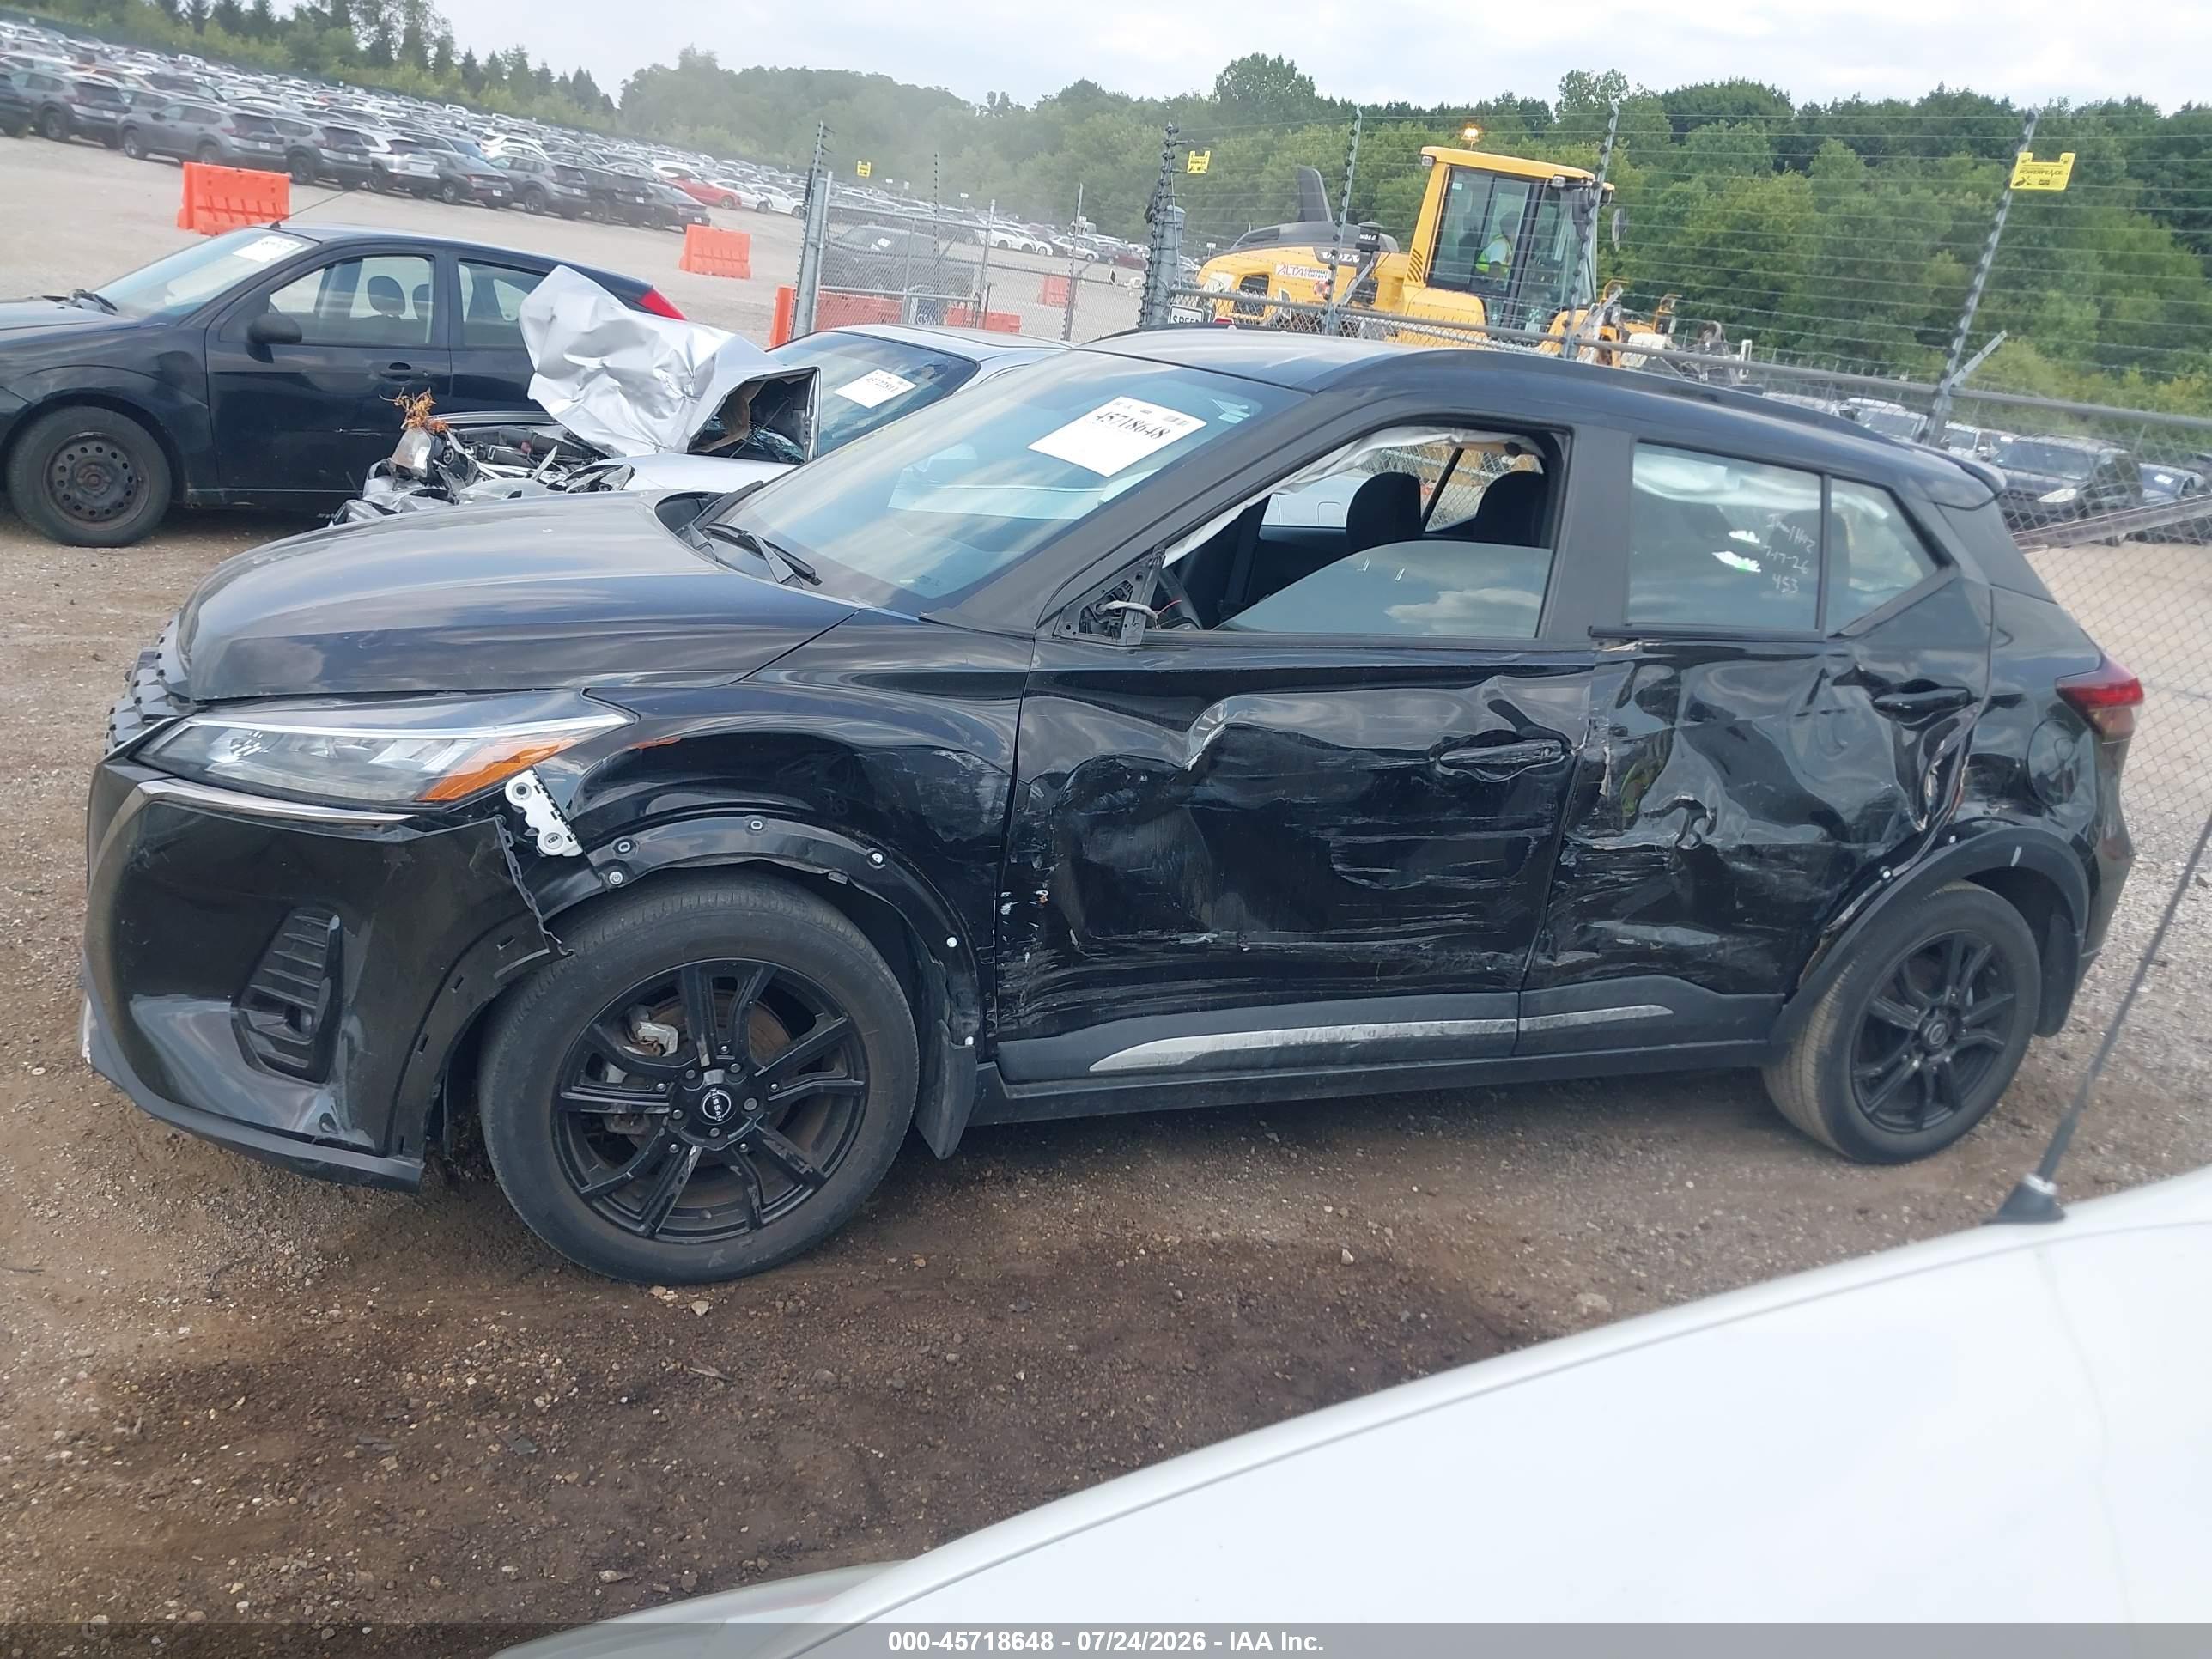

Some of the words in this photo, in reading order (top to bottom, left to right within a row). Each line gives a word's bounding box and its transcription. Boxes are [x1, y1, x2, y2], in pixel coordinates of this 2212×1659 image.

[1277, 264, 1304, 277] ALTA
[1096, 411, 1171, 439] 45718648
[1771, 573, 1799, 593] 453
[709, 1087, 723, 1121] NISSAN
